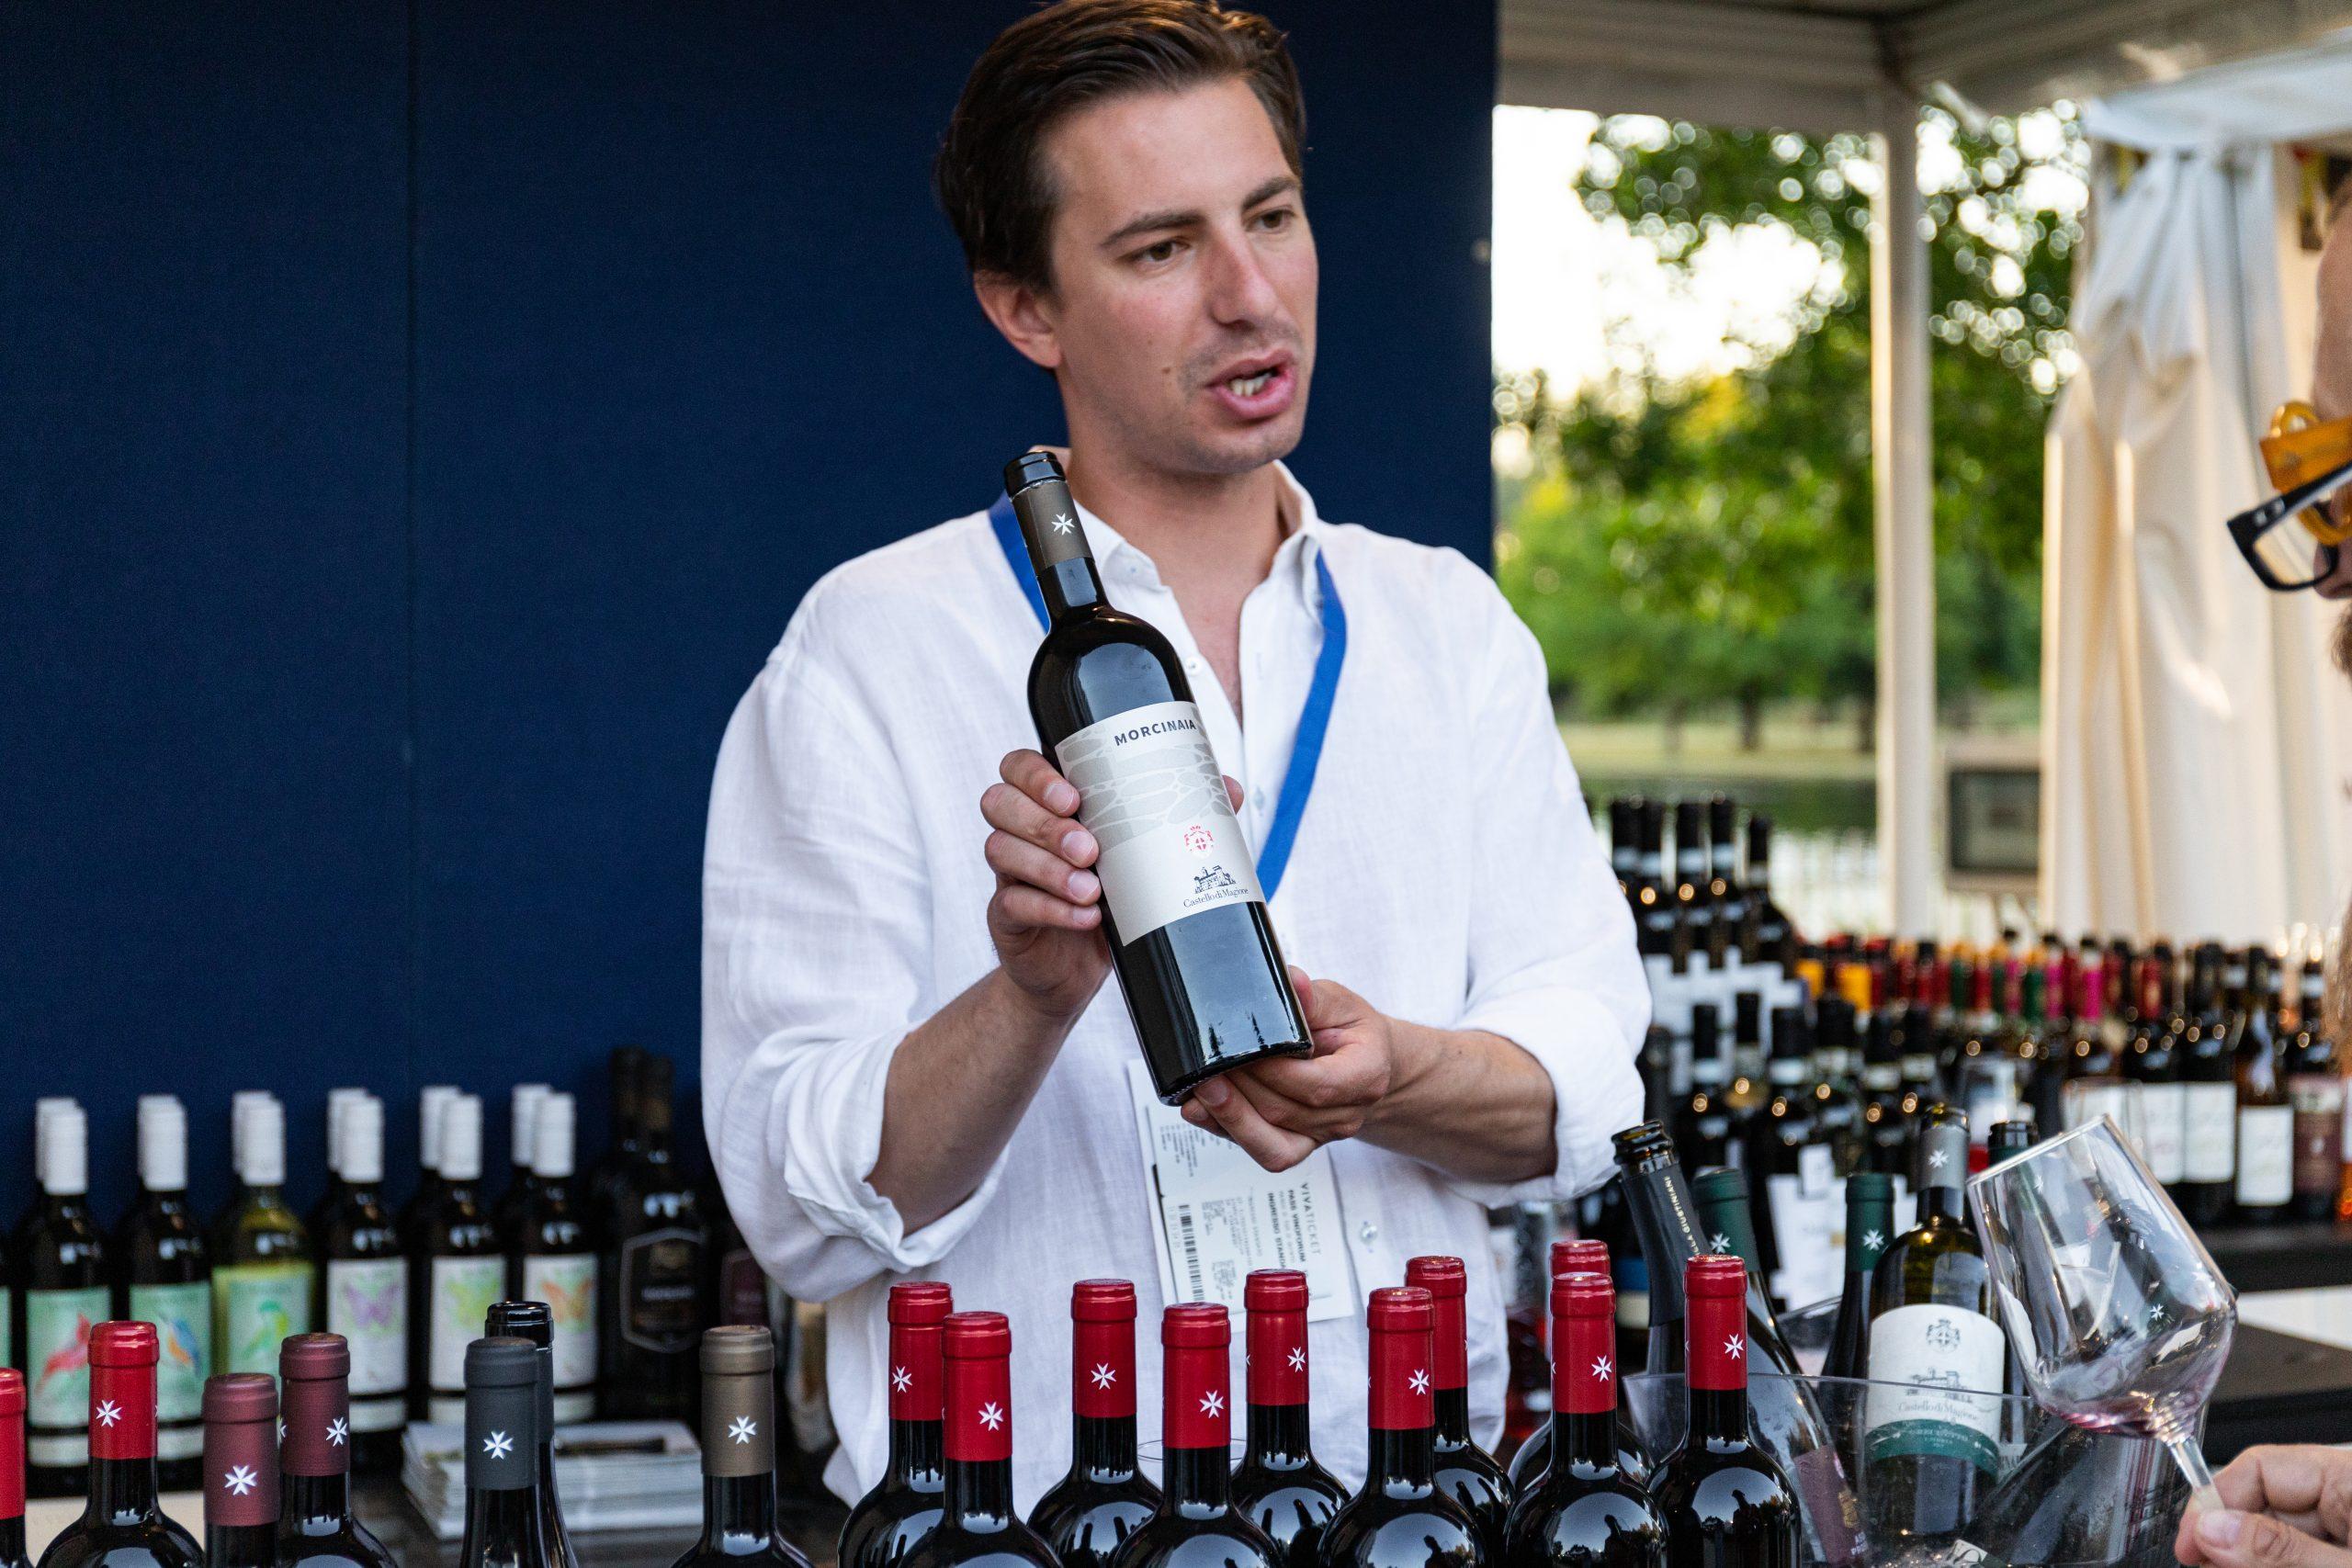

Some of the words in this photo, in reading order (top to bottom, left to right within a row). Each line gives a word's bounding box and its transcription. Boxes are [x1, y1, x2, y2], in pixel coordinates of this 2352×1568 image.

[1114, 719, 1196, 747] MORCINAIA
[1183, 892, 1215, 908] Castello
[1223, 886, 1249, 897] Magione
[1301, 1182, 1320, 1254] VIVATICKET
[1664, 1176, 1690, 1233] GIUSTINIANI
